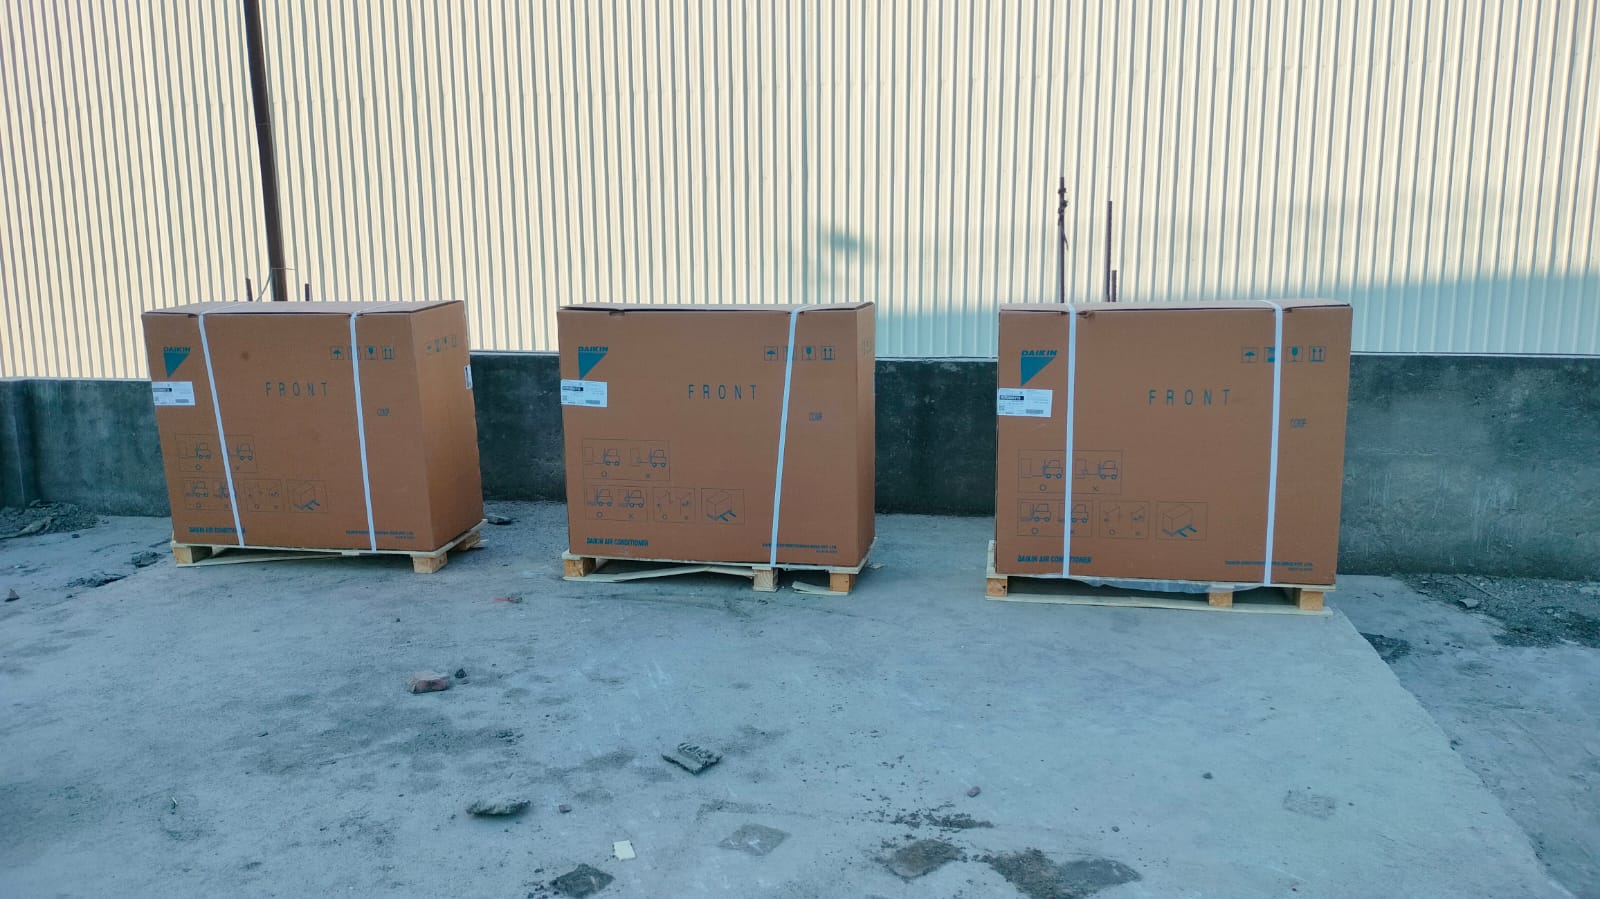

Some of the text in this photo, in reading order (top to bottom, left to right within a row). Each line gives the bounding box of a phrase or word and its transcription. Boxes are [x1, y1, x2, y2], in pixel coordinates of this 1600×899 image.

[265, 382, 328, 397] FRONT
[688, 384, 756, 400] FRONT
[1148, 389, 1230, 406] FRONT
